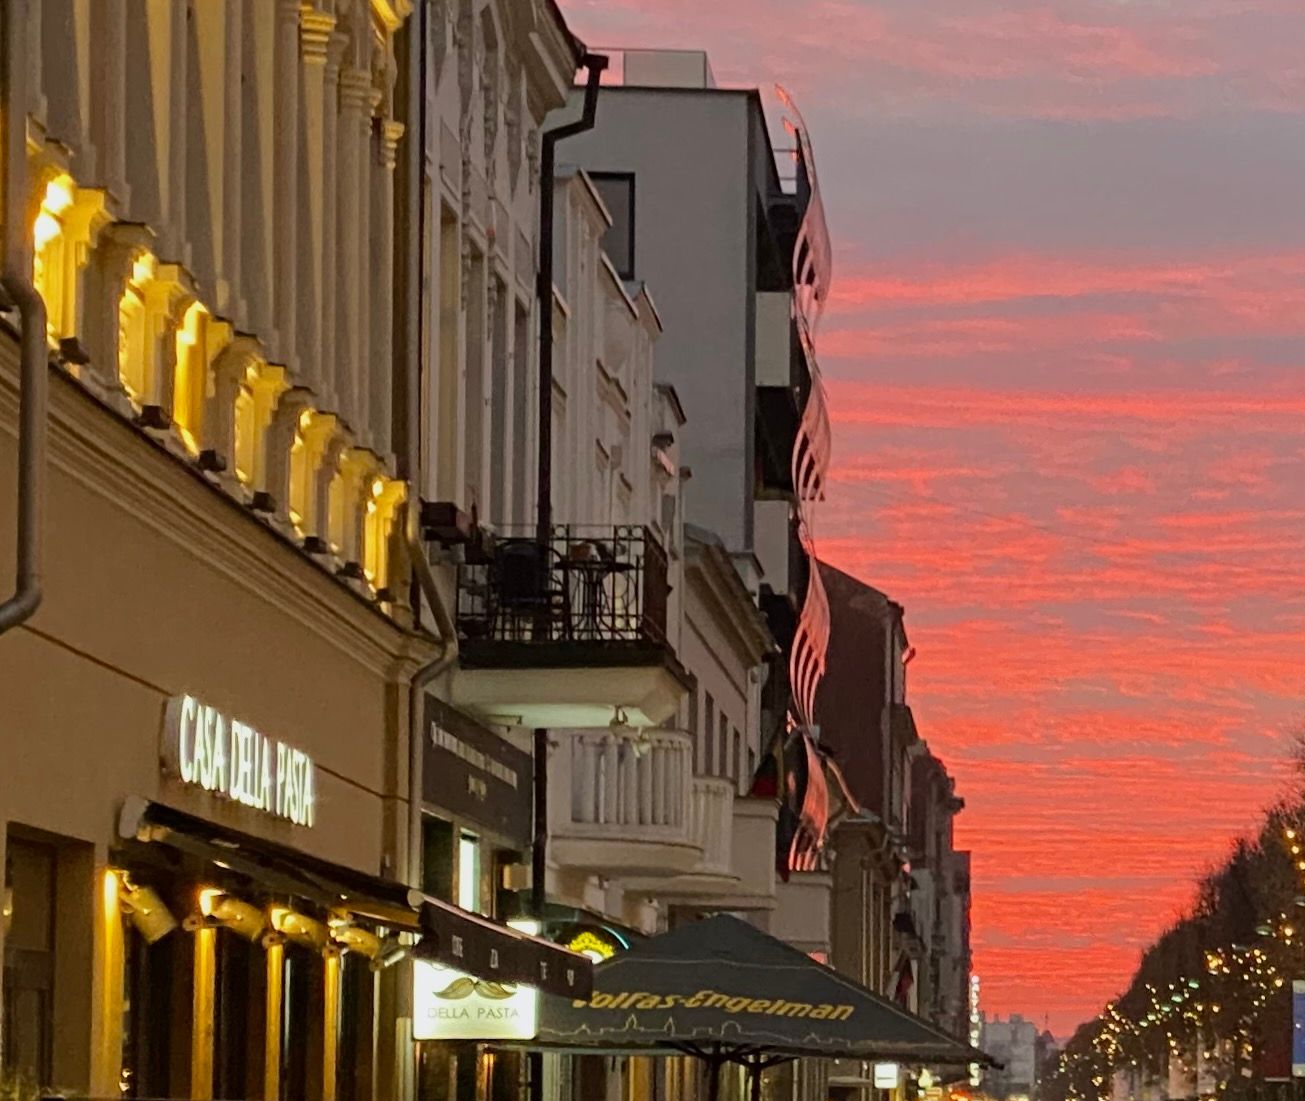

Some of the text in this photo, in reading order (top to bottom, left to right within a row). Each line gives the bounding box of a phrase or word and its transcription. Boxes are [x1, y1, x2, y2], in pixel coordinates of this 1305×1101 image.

[180, 693, 315, 829] CASA DELLA PASTA
[427, 1007, 519, 1019] DELLA PASTA
